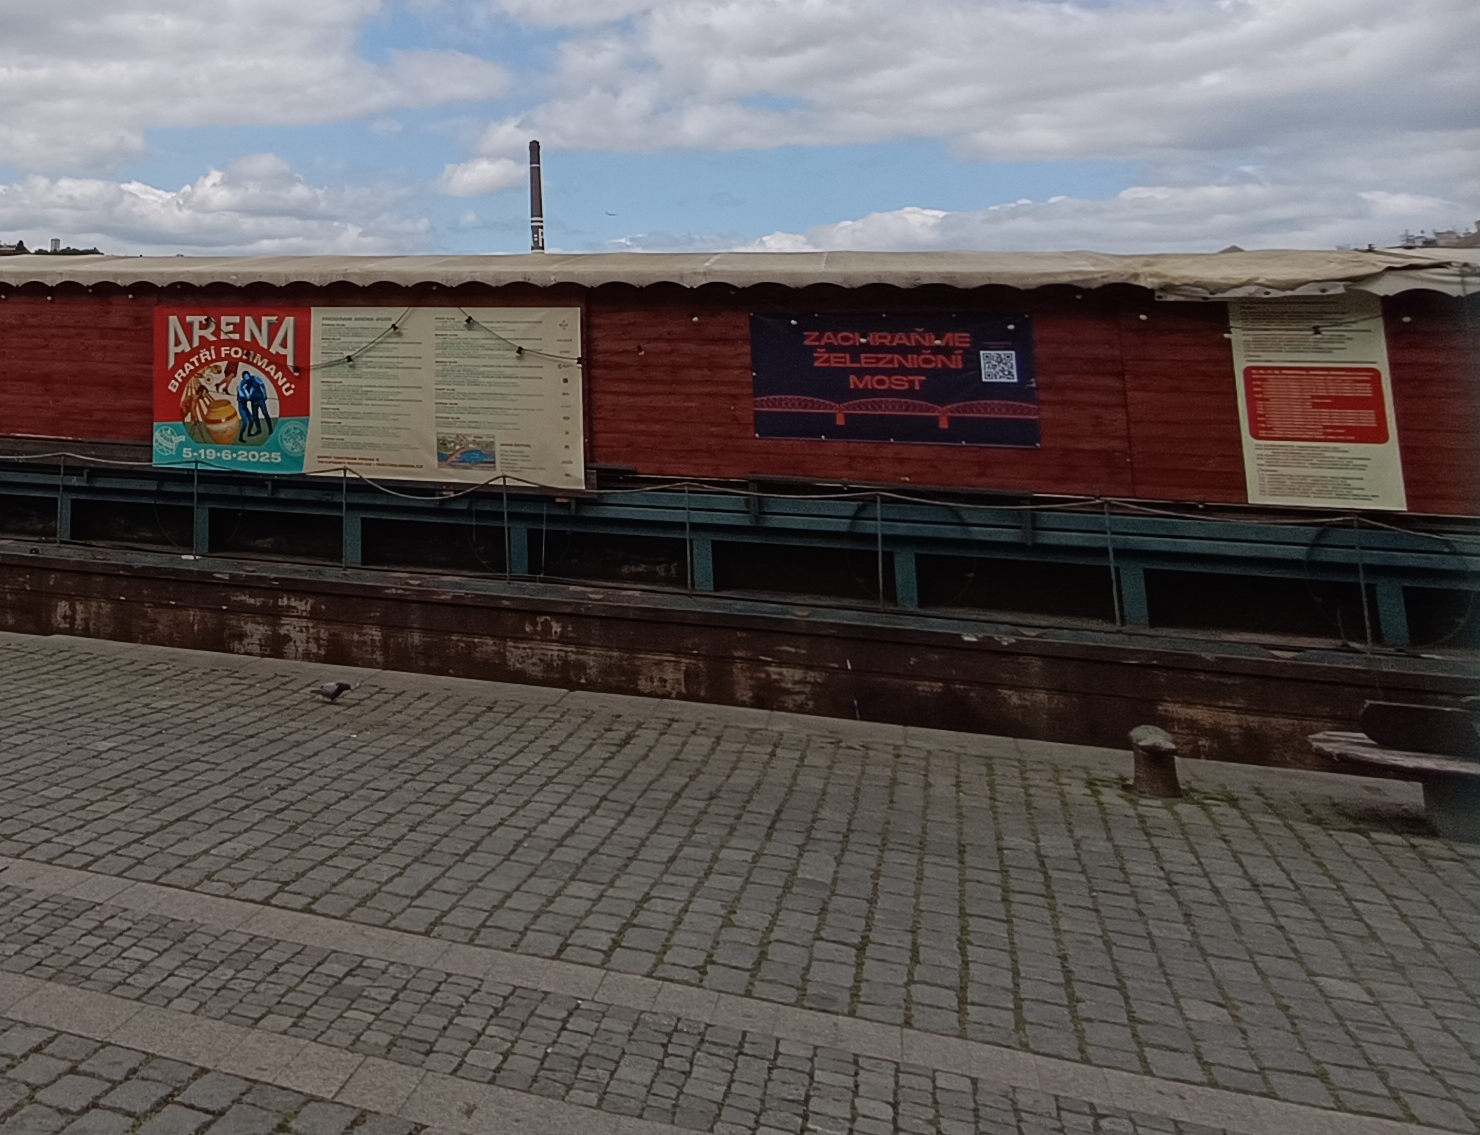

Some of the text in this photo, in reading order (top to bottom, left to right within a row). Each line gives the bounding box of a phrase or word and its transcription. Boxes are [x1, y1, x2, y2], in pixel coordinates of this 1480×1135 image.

[168, 316, 296, 372] ARENA
[803, 328, 971, 347] ZACHRAŇME
[813, 349, 963, 369] ŽELEZNIČNÍ
[168, 346, 216, 393] BRATŘÍ
[849, 375, 926, 390] MOST
